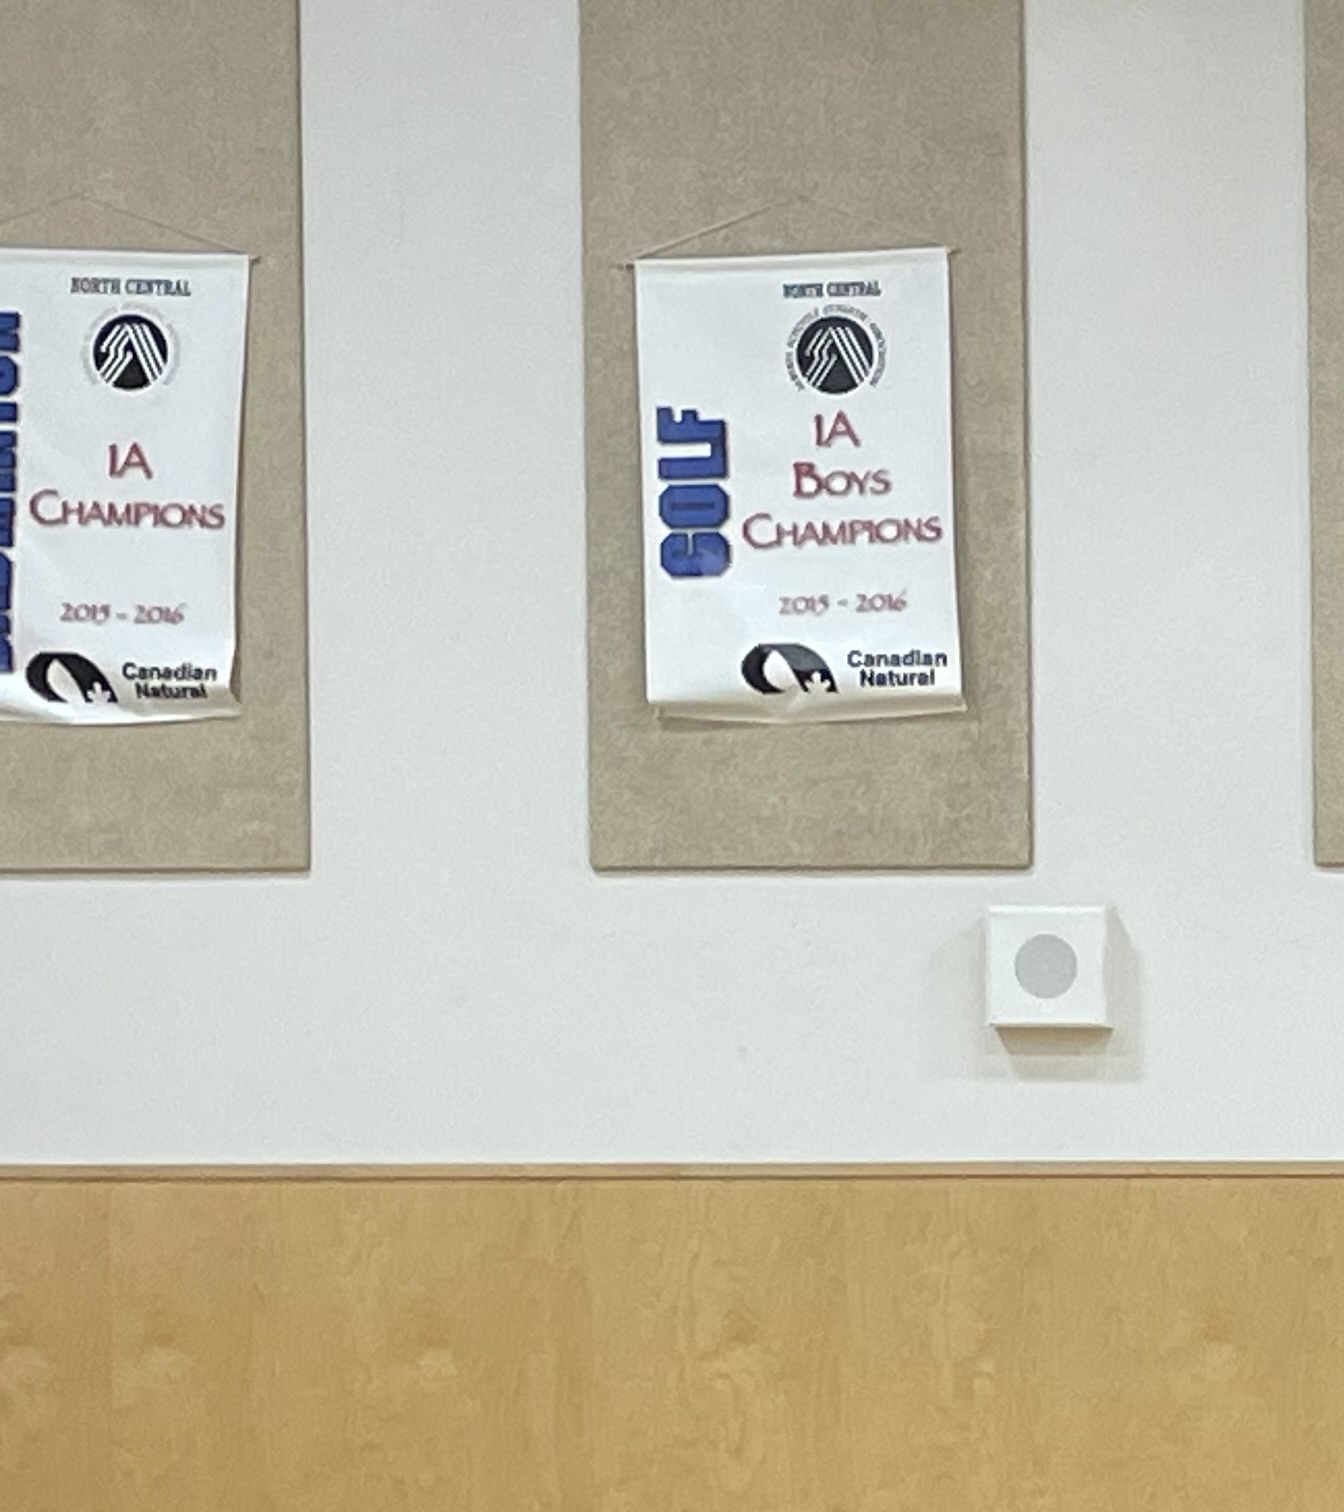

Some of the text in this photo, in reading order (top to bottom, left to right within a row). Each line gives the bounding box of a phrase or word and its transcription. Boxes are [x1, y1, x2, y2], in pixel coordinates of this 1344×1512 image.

[70, 277, 191, 297] NORTH CENTRAL
[656, 406, 732, 578] GOLF
[847, 648, 948, 669] Canadian
[121, 661, 218, 682] Canadian
[858, 669, 935, 688] Natural
[134, 681, 208, 699] Natural
